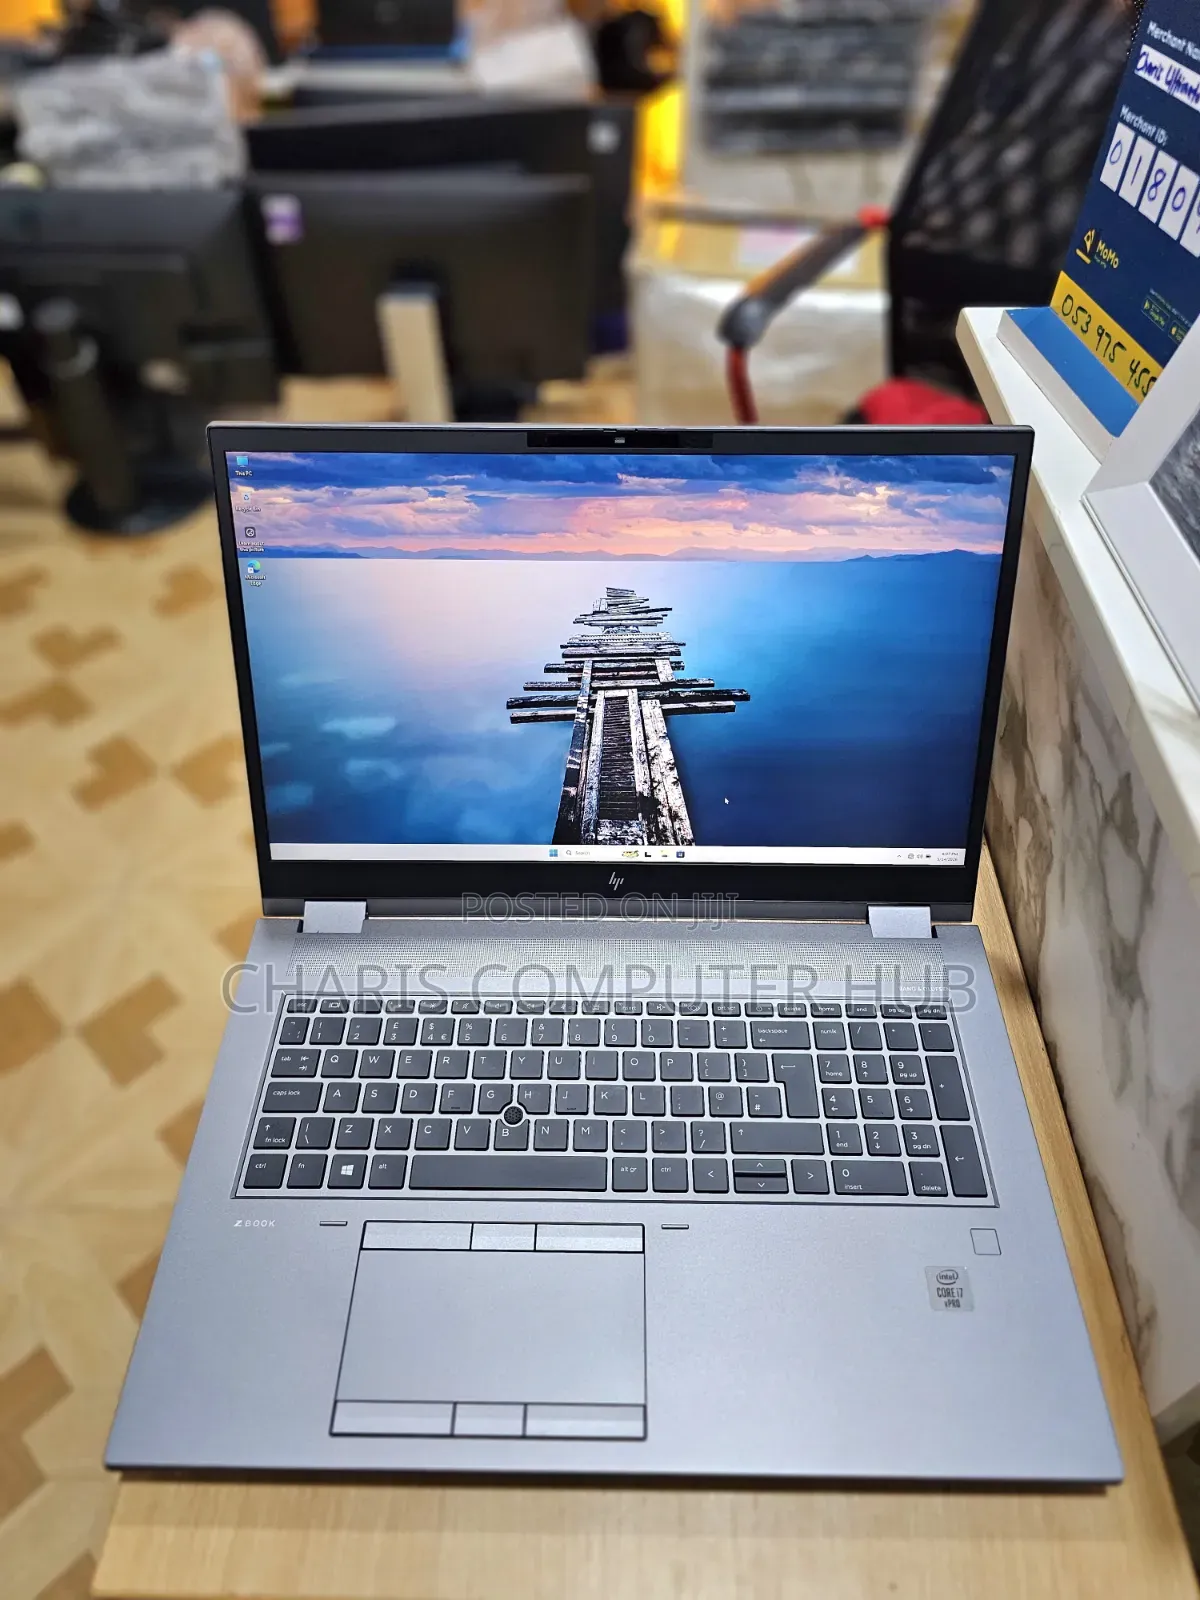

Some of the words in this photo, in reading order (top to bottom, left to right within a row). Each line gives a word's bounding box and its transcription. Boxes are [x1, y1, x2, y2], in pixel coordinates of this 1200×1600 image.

[1147, 20, 1187, 52] Merchant
[1120, 104, 1157, 138] Merchant
[1097, 239, 1120, 269] MoMo
[1061, 294, 1092, 335] 053
[1096, 325, 1127, 363] 975
[609, 871, 624, 891] hp
[936, 1287, 955, 1298] CORE
